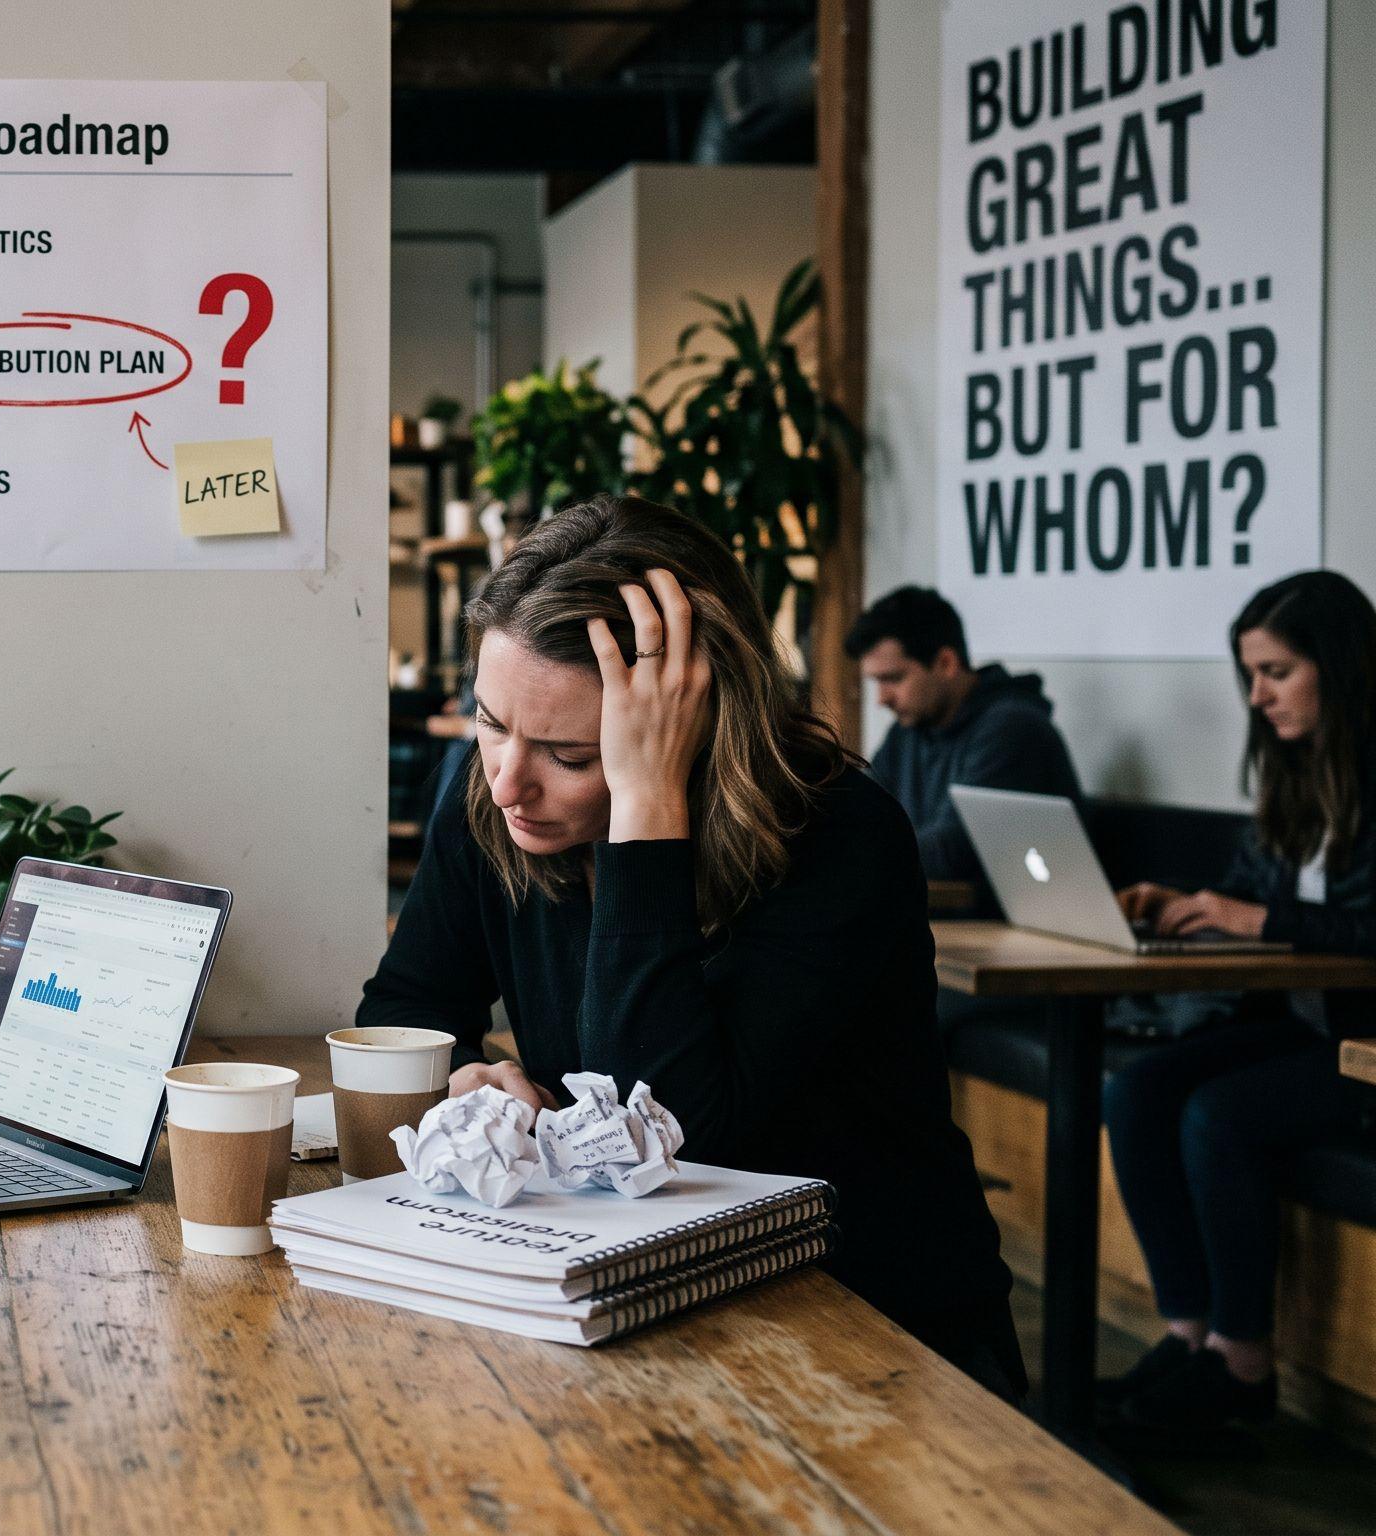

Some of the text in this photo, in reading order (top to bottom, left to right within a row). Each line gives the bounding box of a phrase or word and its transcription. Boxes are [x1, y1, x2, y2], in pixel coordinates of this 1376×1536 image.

[966, 0, 1280, 145] BUILDING
[966, 91, 1205, 255] GREAT
[198, 272, 274, 405] ?
[963, 223, 1273, 354] THINGS...
[99, 350, 165, 374] PLAN
[965, 326, 1278, 461] BUT FOR
[184, 469, 270, 505] LATER
[962, 453, 1267, 576] WHOM?
[419, 1220, 569, 1254] feature
